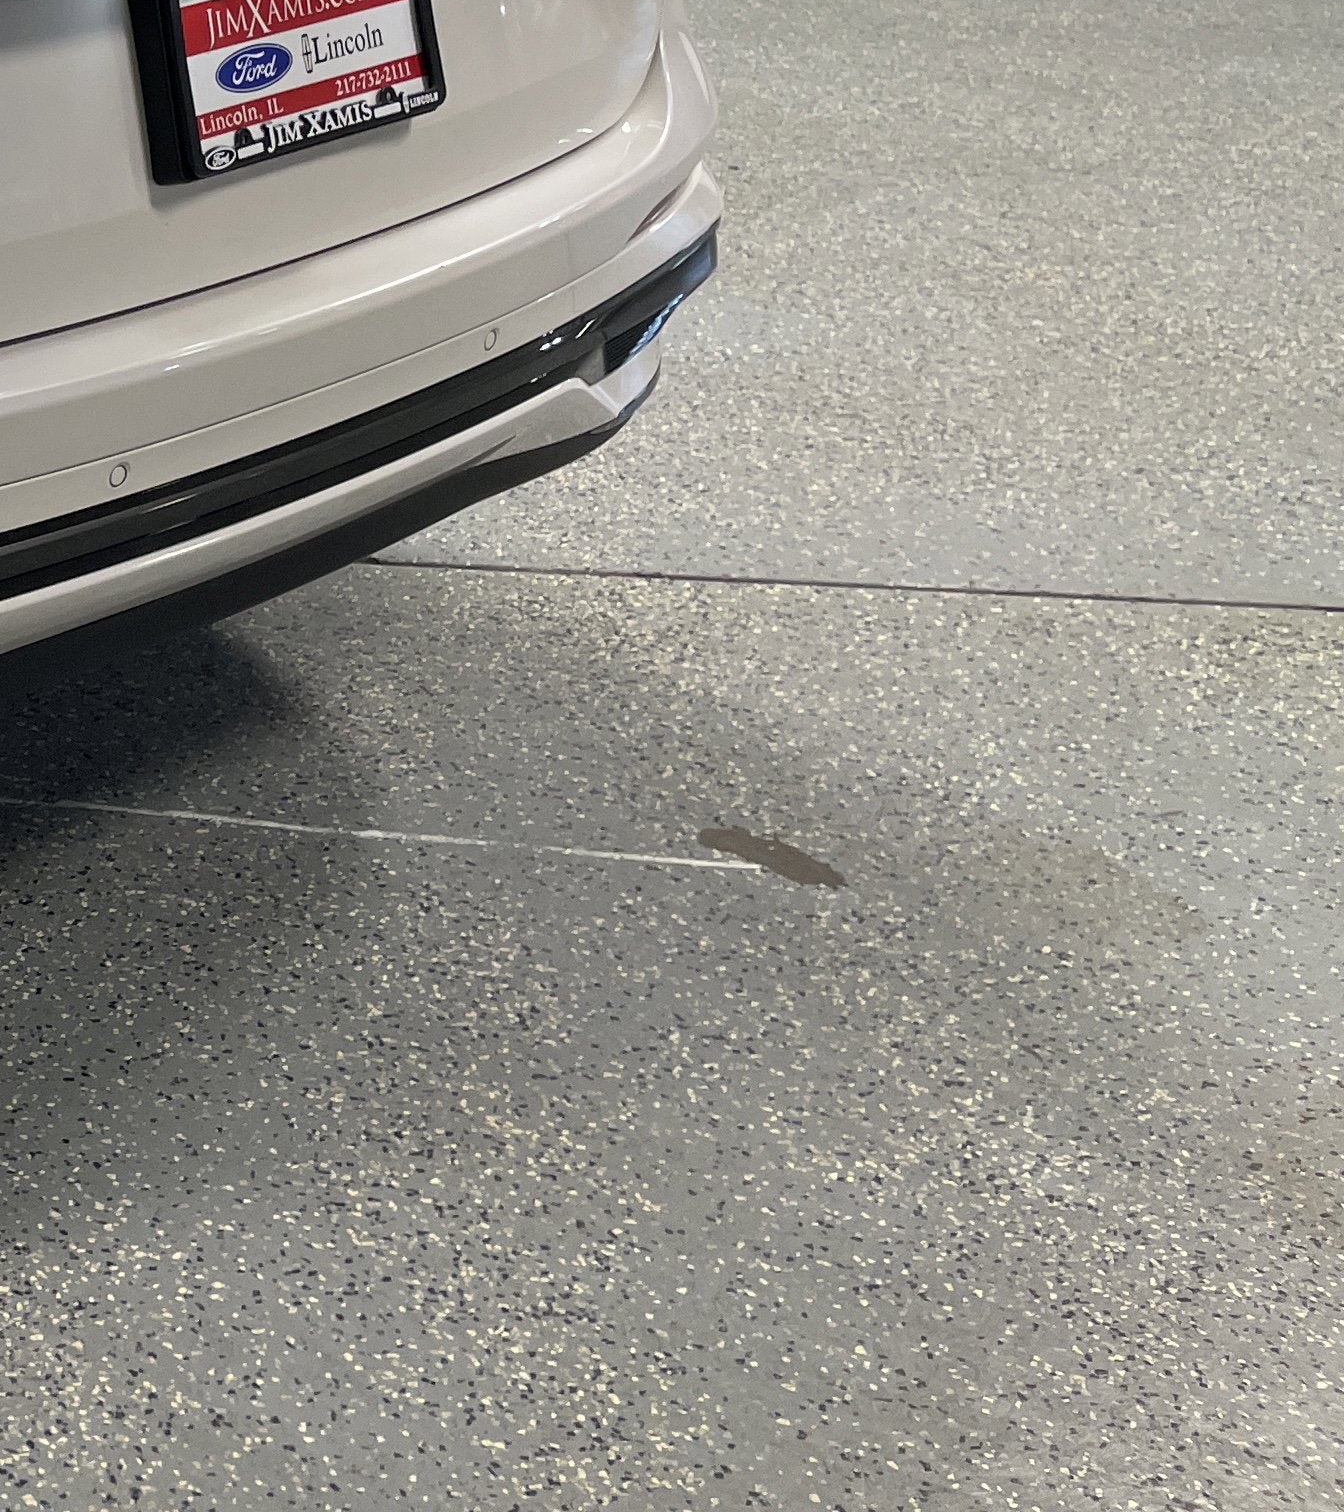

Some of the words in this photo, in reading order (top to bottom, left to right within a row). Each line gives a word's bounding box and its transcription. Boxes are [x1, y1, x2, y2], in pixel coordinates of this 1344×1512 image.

[312, 23, 385, 64] Lincoln
[232, 50, 277, 86] Ford
[335, 60, 412, 97] 217-732-2111
[267, 97, 284, 116] IL
[266, 120, 304, 153] JIM
[306, 102, 372, 138] XAMIS
